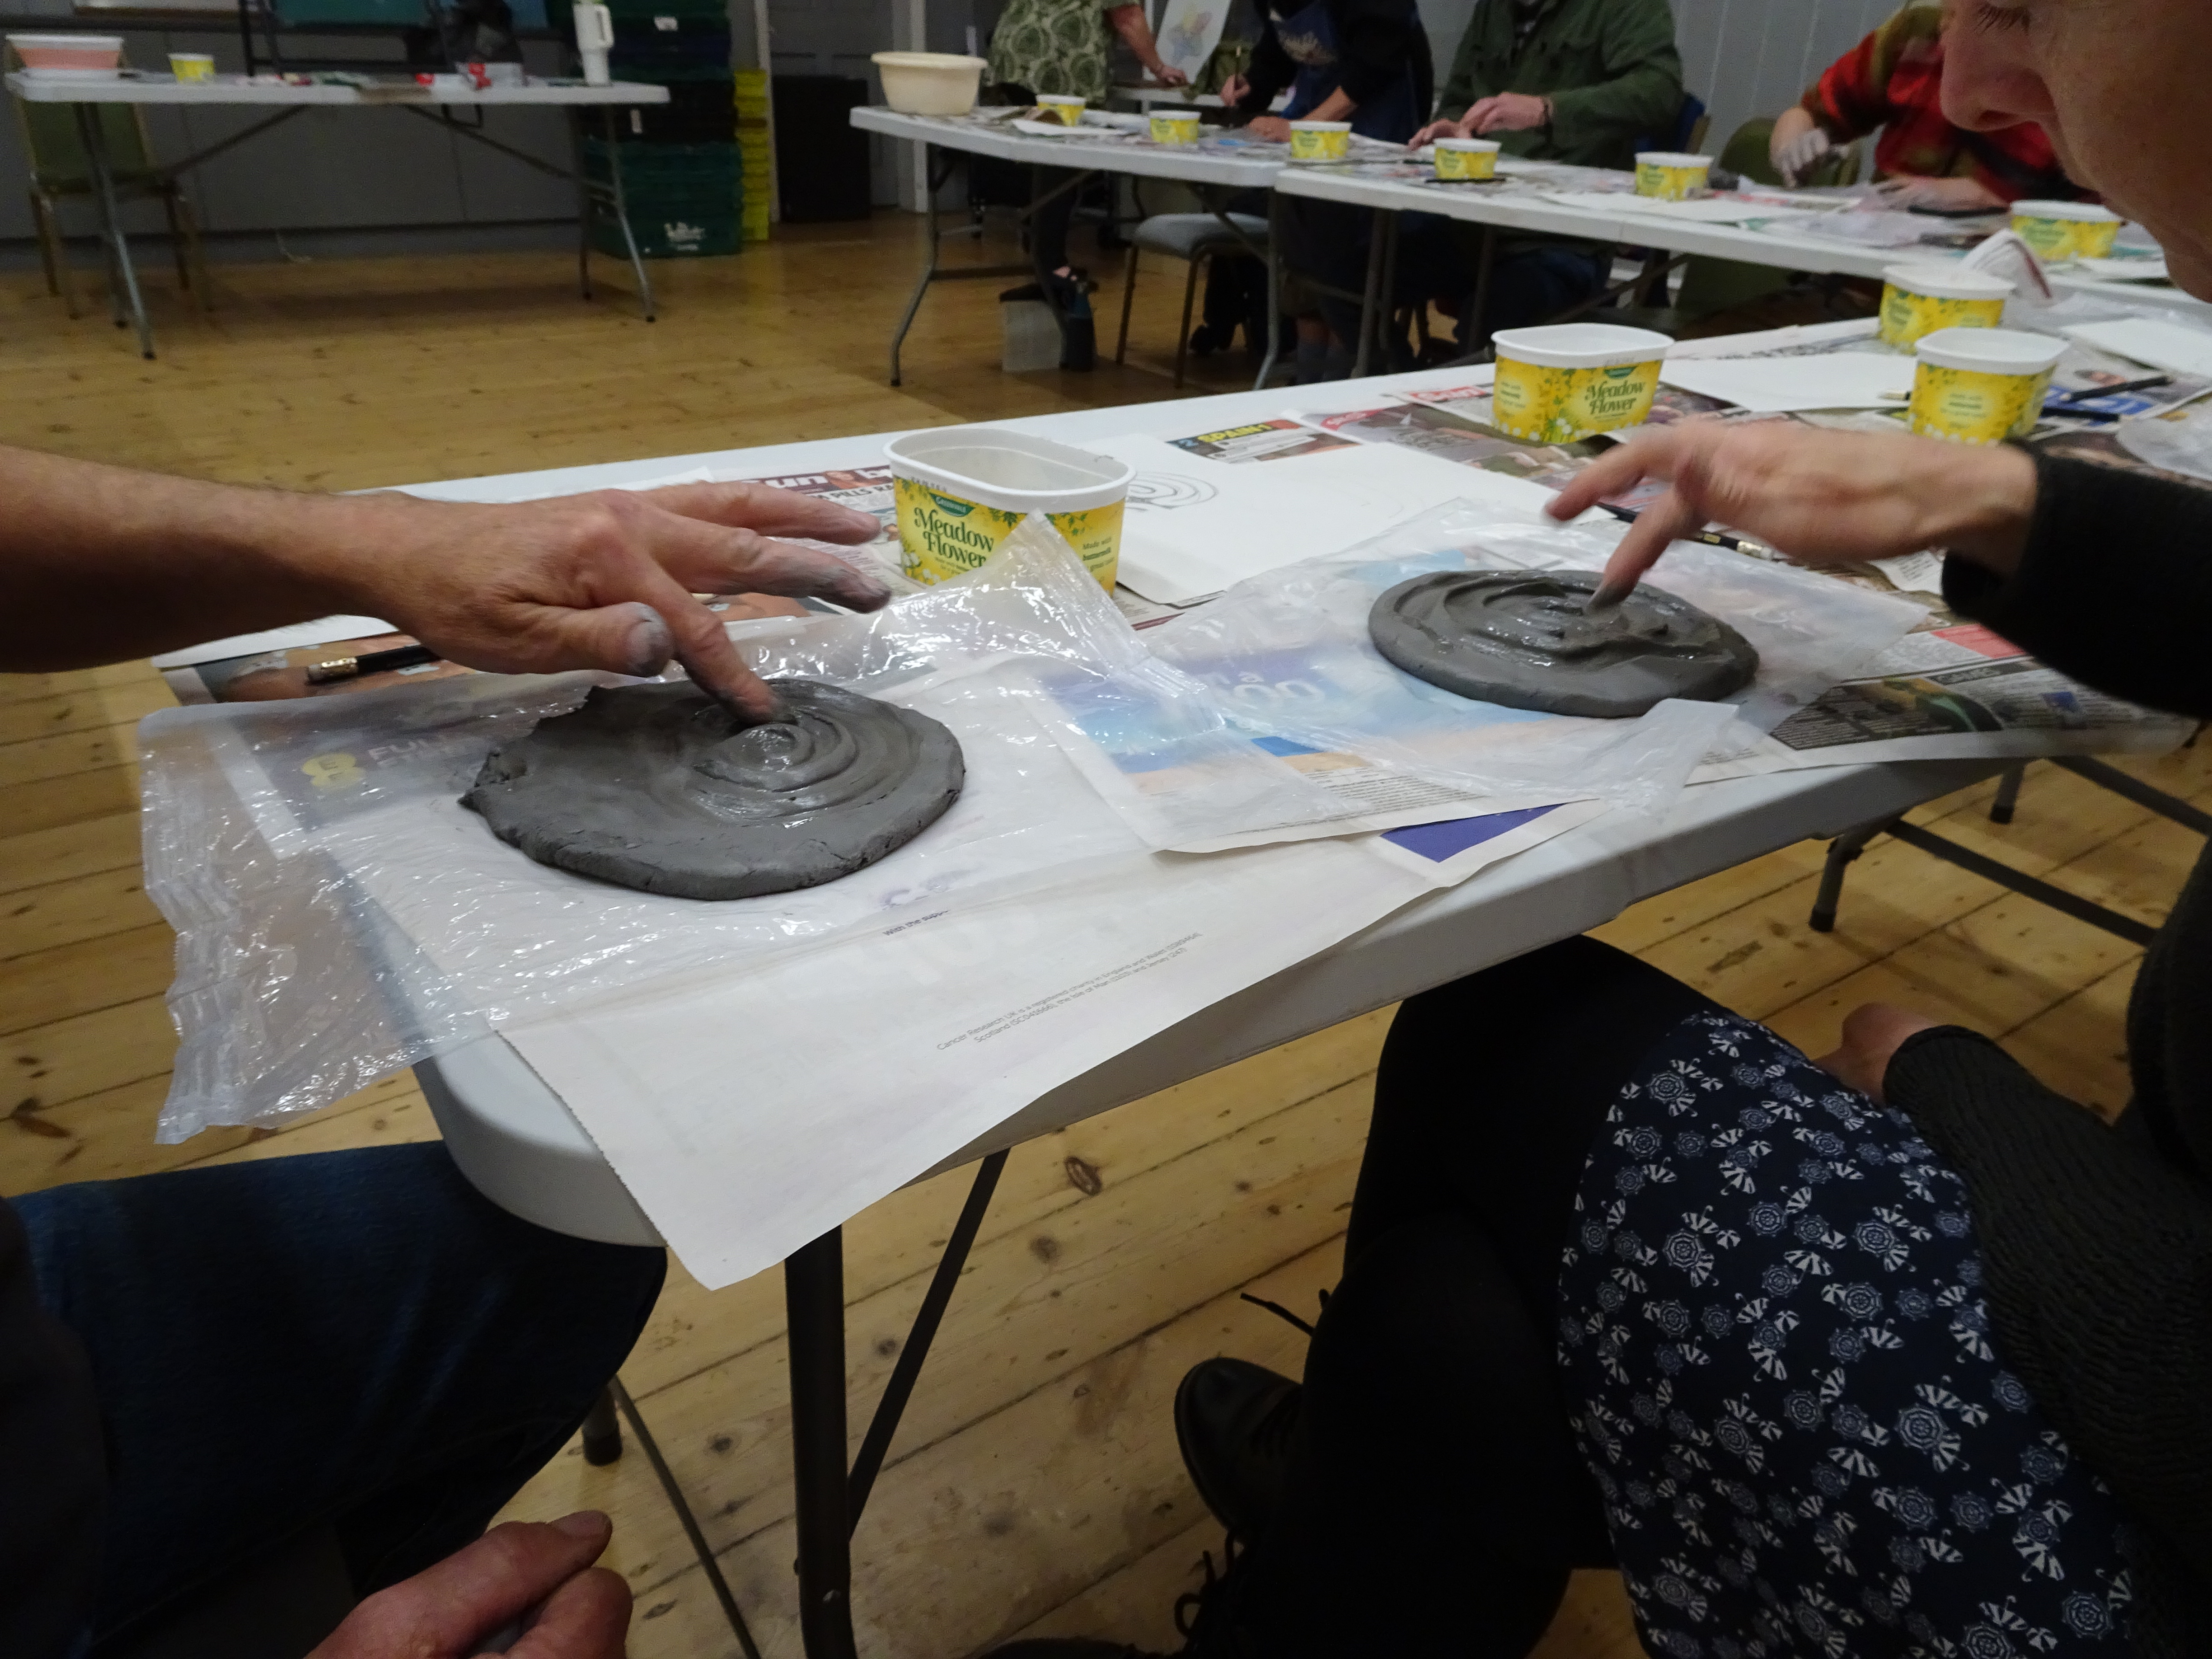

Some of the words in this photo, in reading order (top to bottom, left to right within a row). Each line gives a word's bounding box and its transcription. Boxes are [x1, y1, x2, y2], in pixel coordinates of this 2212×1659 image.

[1584, 380, 1646, 400] Meadow
[1589, 397, 1636, 415] Flower
[741, 476, 829, 489] un
[831, 488, 872, 498] PILLS
[914, 507, 994, 553] Meadow
[923, 531, 986, 568] Flower
[882, 926, 907, 936] With
[905, 919, 922, 928] the
[937, 1034, 968, 1050] Cancer
[966, 1017, 1004, 1035] Research
[1031, 990, 1069, 1008] registered
[1101, 964, 1132, 978] England
[1132, 958, 1147, 966] and
[974, 1023, 1011, 1043] Scotland
[1092, 980, 1110, 989] Man
